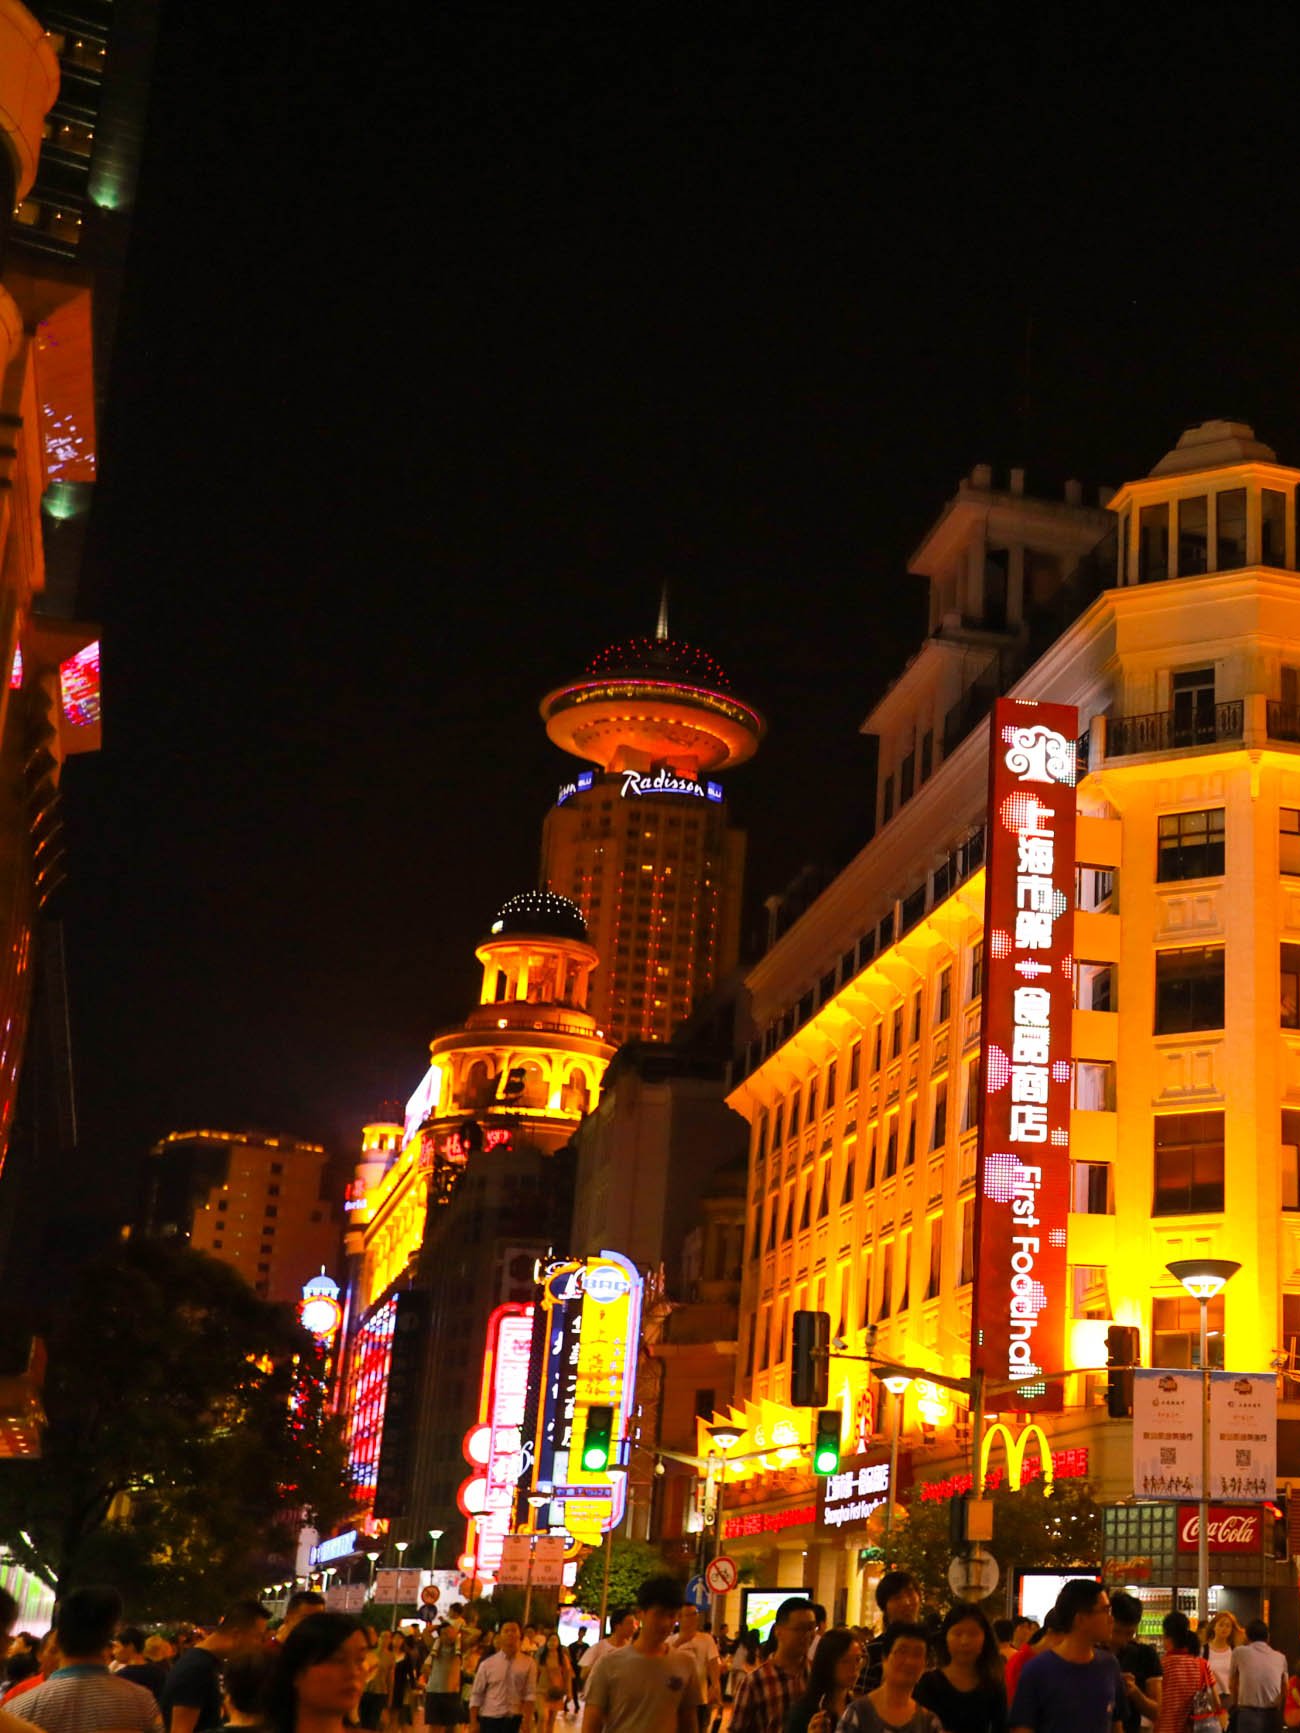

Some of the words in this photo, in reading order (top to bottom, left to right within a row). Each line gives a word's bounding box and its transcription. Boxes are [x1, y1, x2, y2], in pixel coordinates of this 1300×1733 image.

[620, 768, 704, 798] Radisson
[1009, 800, 1055, 1143] 上海市第一食品商店
[1012, 1166, 1041, 1228] First
[1009, 1237, 1039, 1380] Foodhall
